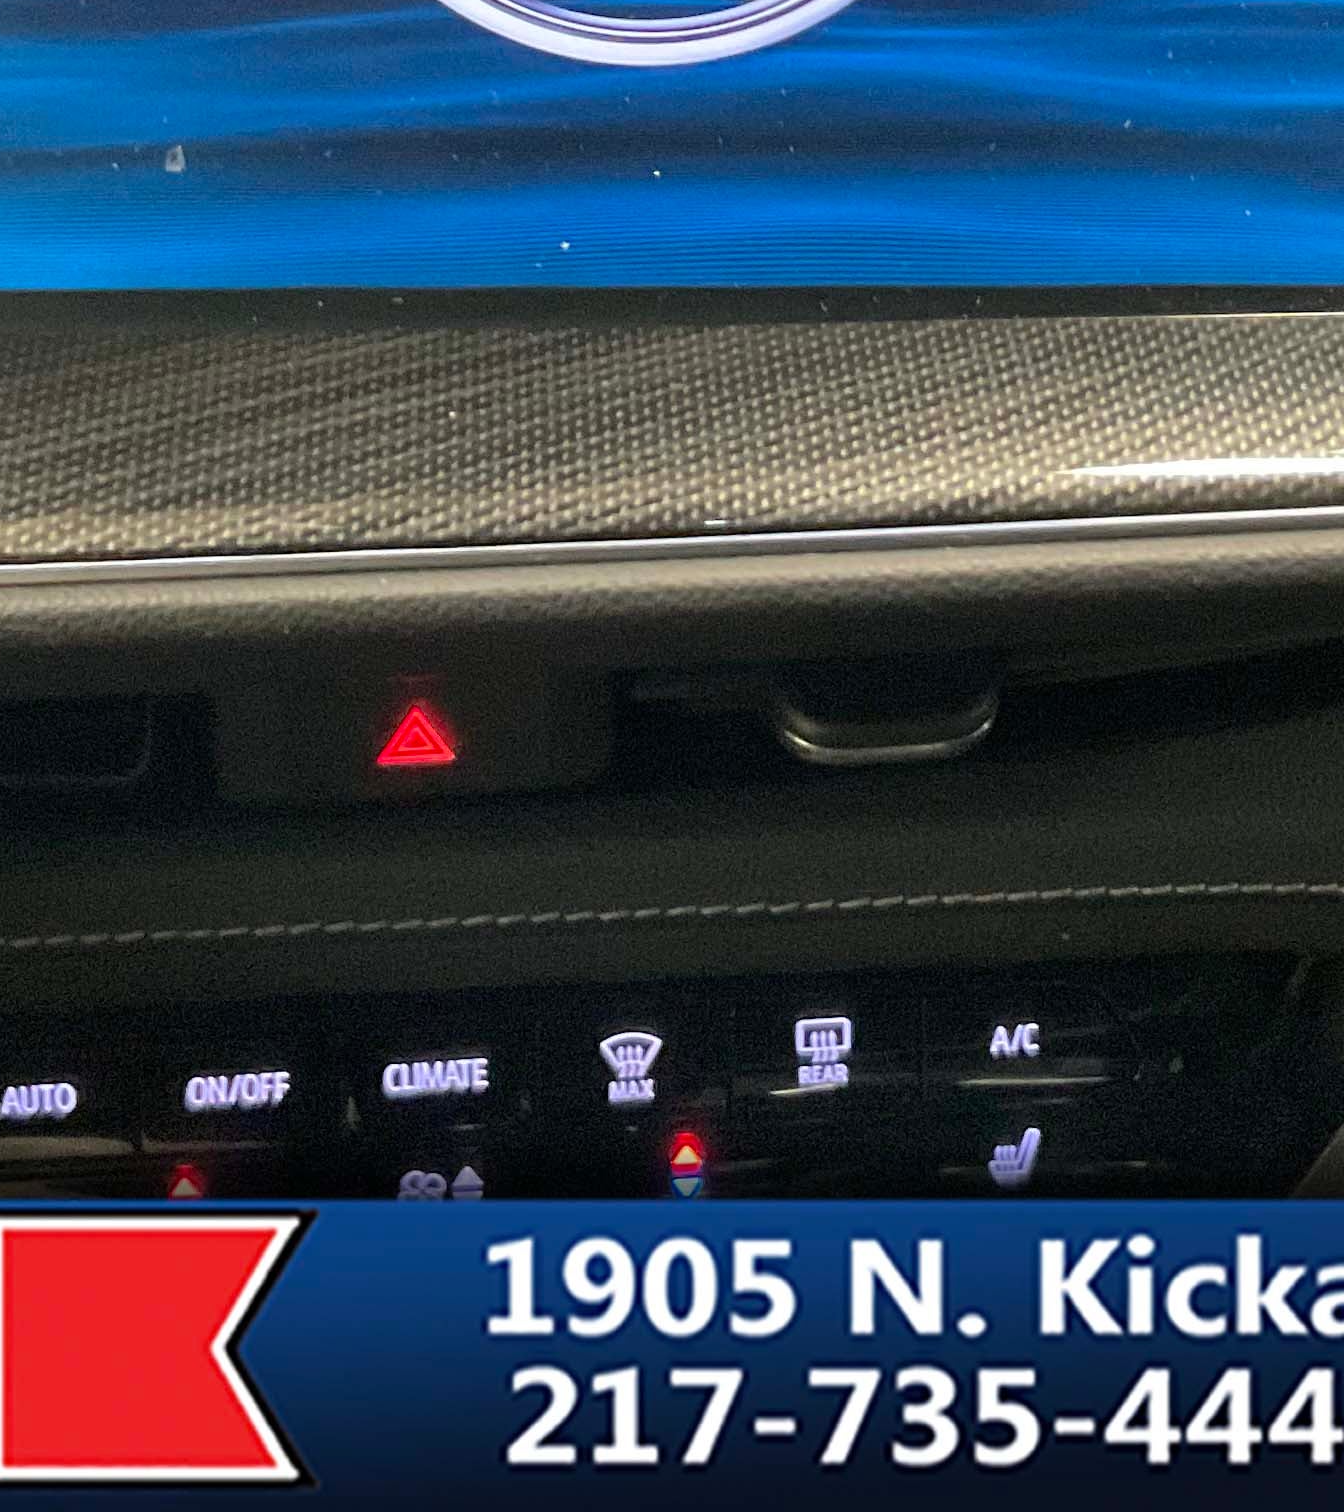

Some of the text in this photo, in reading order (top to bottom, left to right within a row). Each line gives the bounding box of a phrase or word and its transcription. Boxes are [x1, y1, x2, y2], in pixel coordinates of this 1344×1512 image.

[989, 1022, 1041, 1057] A/C
[184, 1071, 292, 1111] ON/OFF
[382, 1057, 490, 1099] CLIMATE
[608, 1079, 655, 1103] MAX
[797, 1063, 849, 1087] REAR
[0, 1081, 78, 1119] AUTO
